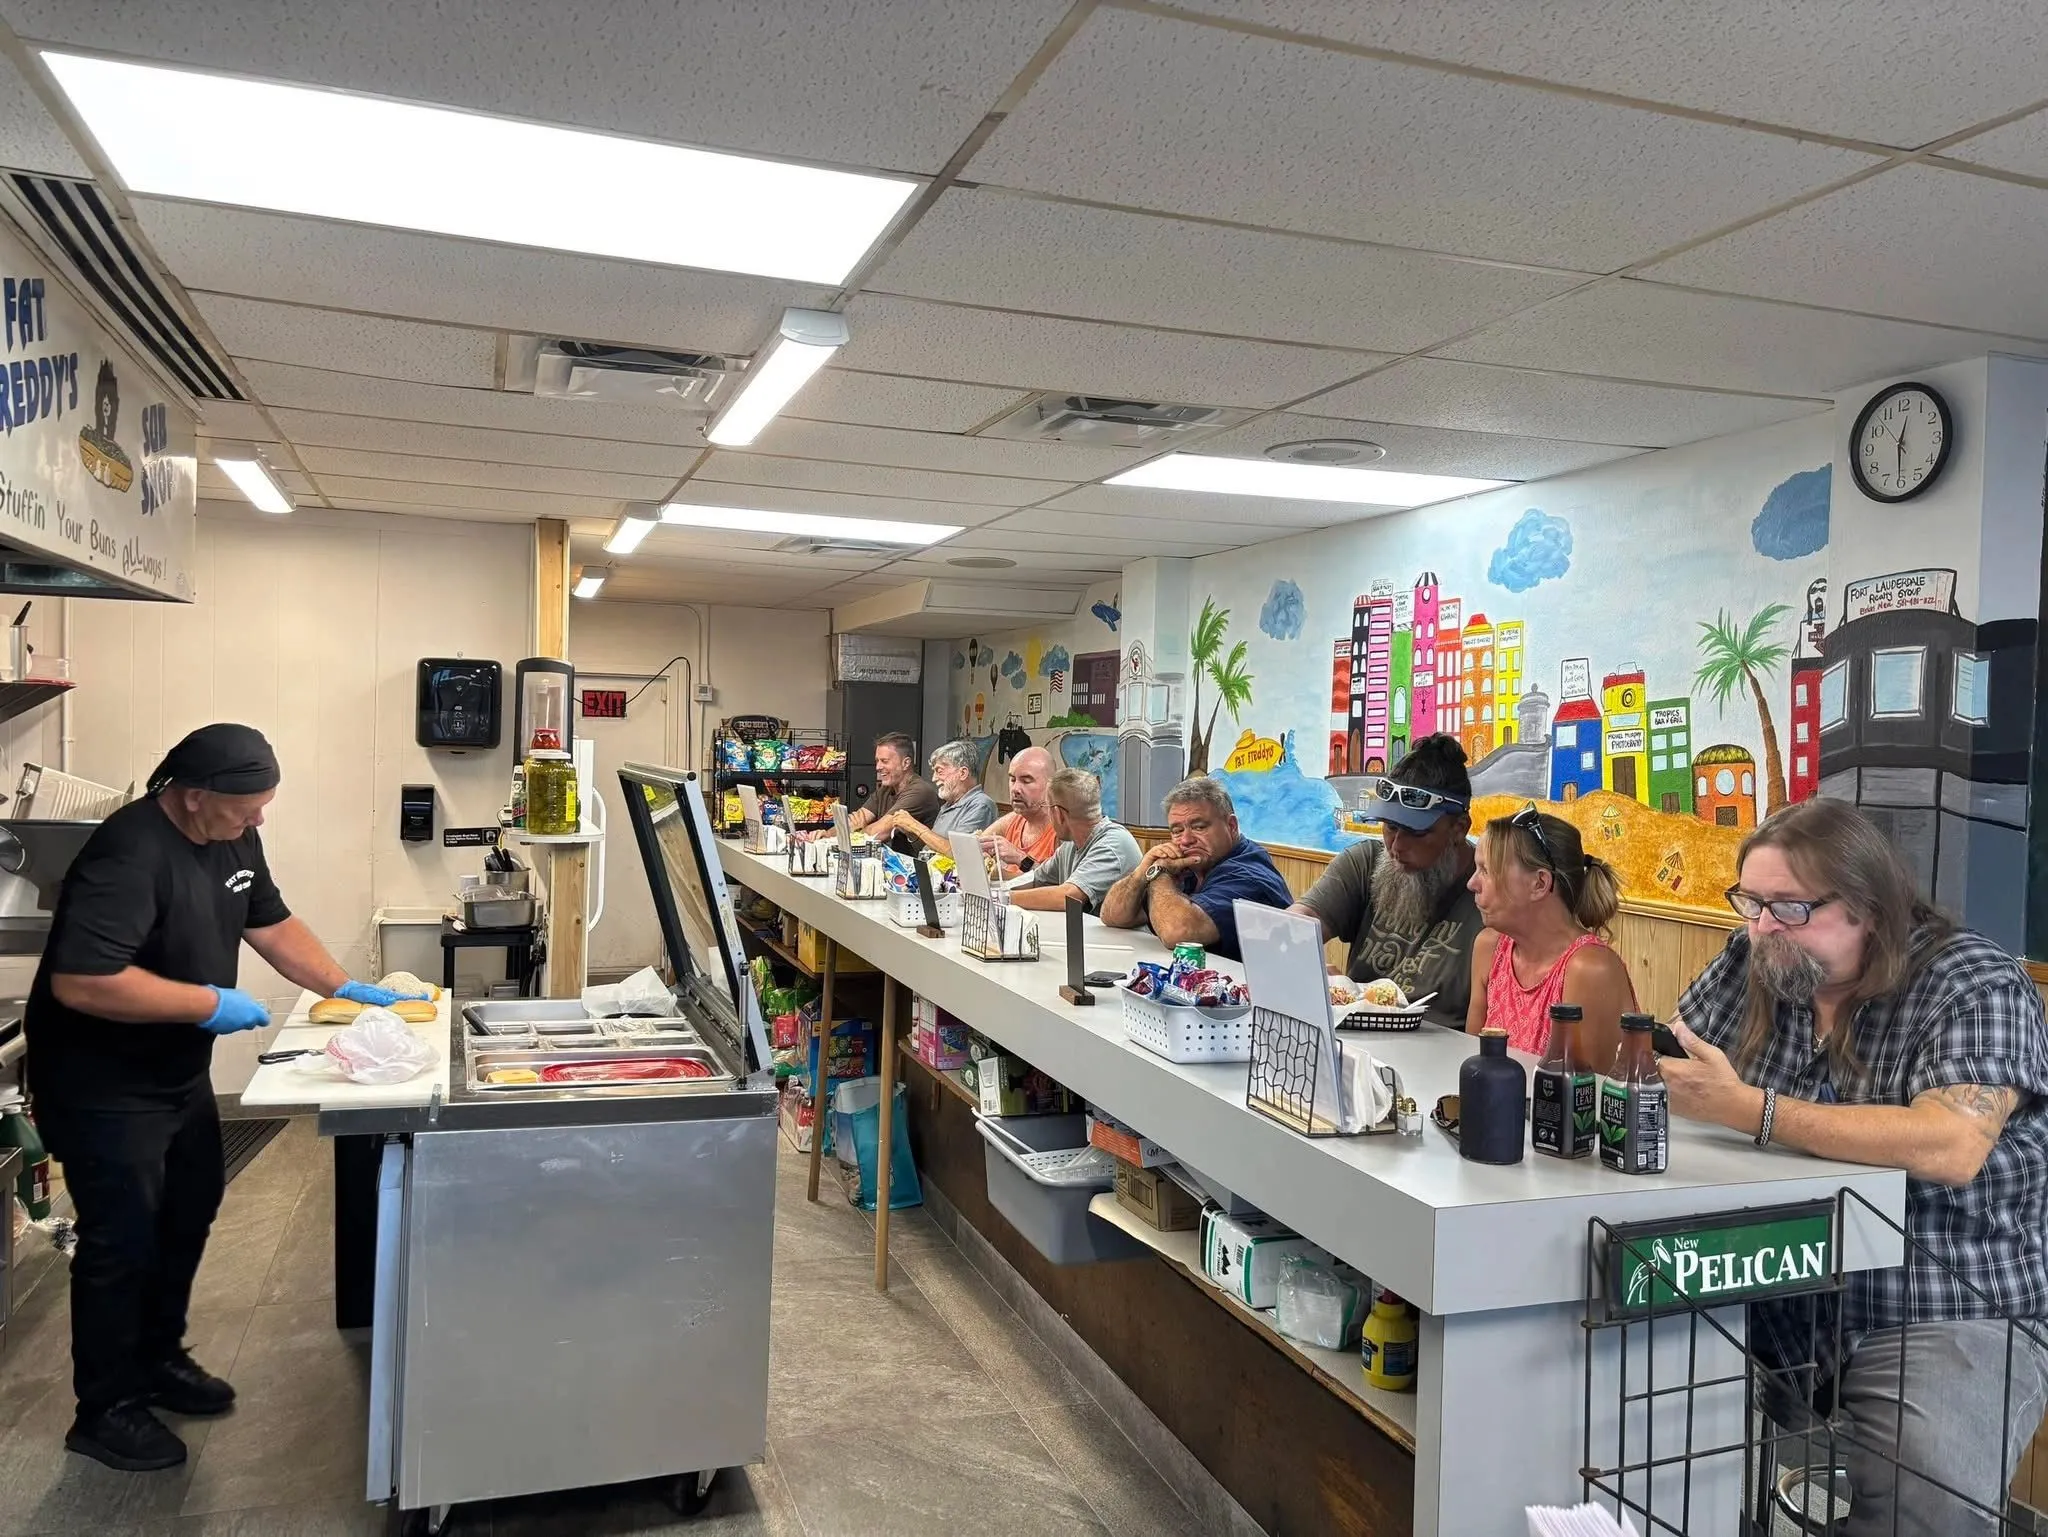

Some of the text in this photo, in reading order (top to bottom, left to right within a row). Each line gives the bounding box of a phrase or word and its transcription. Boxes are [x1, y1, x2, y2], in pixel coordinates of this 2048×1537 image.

[4, 277, 46, 354] FAT
[0, 352, 78, 438] REDDY'S
[1898, 398, 1911, 412] 12
[1919, 400, 1923, 413] 1
[1883, 407, 1893, 420] 11
[1927, 411, 1937, 425] 2
[142, 402, 167, 457] SUB
[1871, 424, 1885, 438] 10
[1931, 430, 1942, 445] 3
[1865, 443, 1875, 457] 9
[1925, 452, 1936, 465] 4
[1869, 461, 1879, 475] 8
[1912, 467, 1923, 481] 5
[1881, 473, 1891, 486] 7
[1896, 475, 1906, 488] 6
[57, 500, 83, 544] Your
[90, 519, 116, 560] Buns
[1850, 576, 1926, 602] FORT LAUDERDALE
[583, 691, 625, 716] EXIT
[1575, 1084, 1594, 1098] PURE
[1575, 1094, 1594, 1107] LEAF
[1603, 1095, 1625, 1111] PURE
[1603, 1106, 1625, 1121] LEAF
[1674, 1237, 1700, 1251] New
